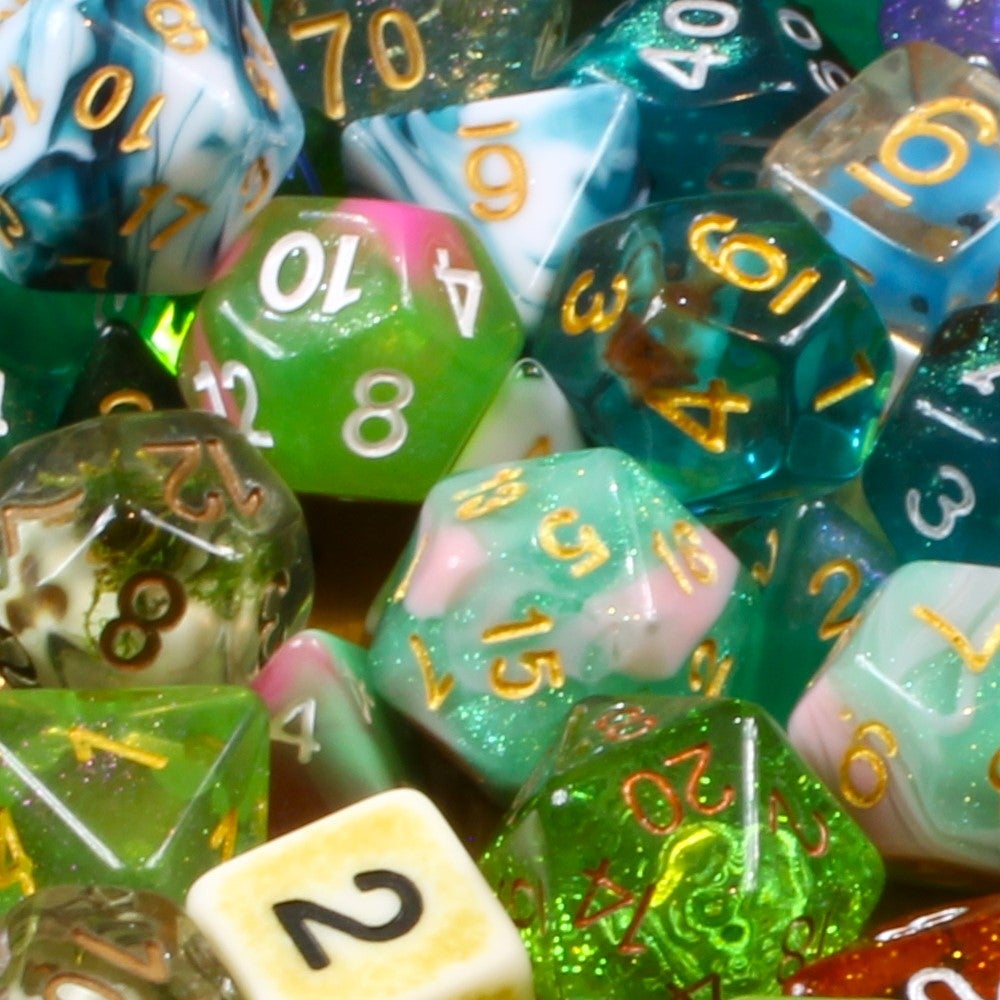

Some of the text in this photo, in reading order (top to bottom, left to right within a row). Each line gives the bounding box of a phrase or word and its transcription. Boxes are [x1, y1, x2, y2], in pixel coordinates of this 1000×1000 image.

[290, 9, 425, 120] 70
[637, 0, 739, 91] 40
[259, 231, 363, 315] 10
[434, 247, 483, 338] 4
[561, 269, 628, 336] 3
[194, 361, 274, 448] 12
[342, 369, 415, 458] 8
[648, 378, 752, 454] 4
[814, 351, 876, 412] 1
[537, 508, 610, 578] 5
[905, 464, 976, 541] 3
[100, 569, 188, 671] 8
[808, 558, 866, 641] 2
[481, 607, 564, 699] 15
[68, 726, 170, 771] 1
[269, 698, 321, 765] 4
[622, 742, 736, 835] 20
[272, 868, 424, 971] 2
[575, 858, 656, 955] 14
